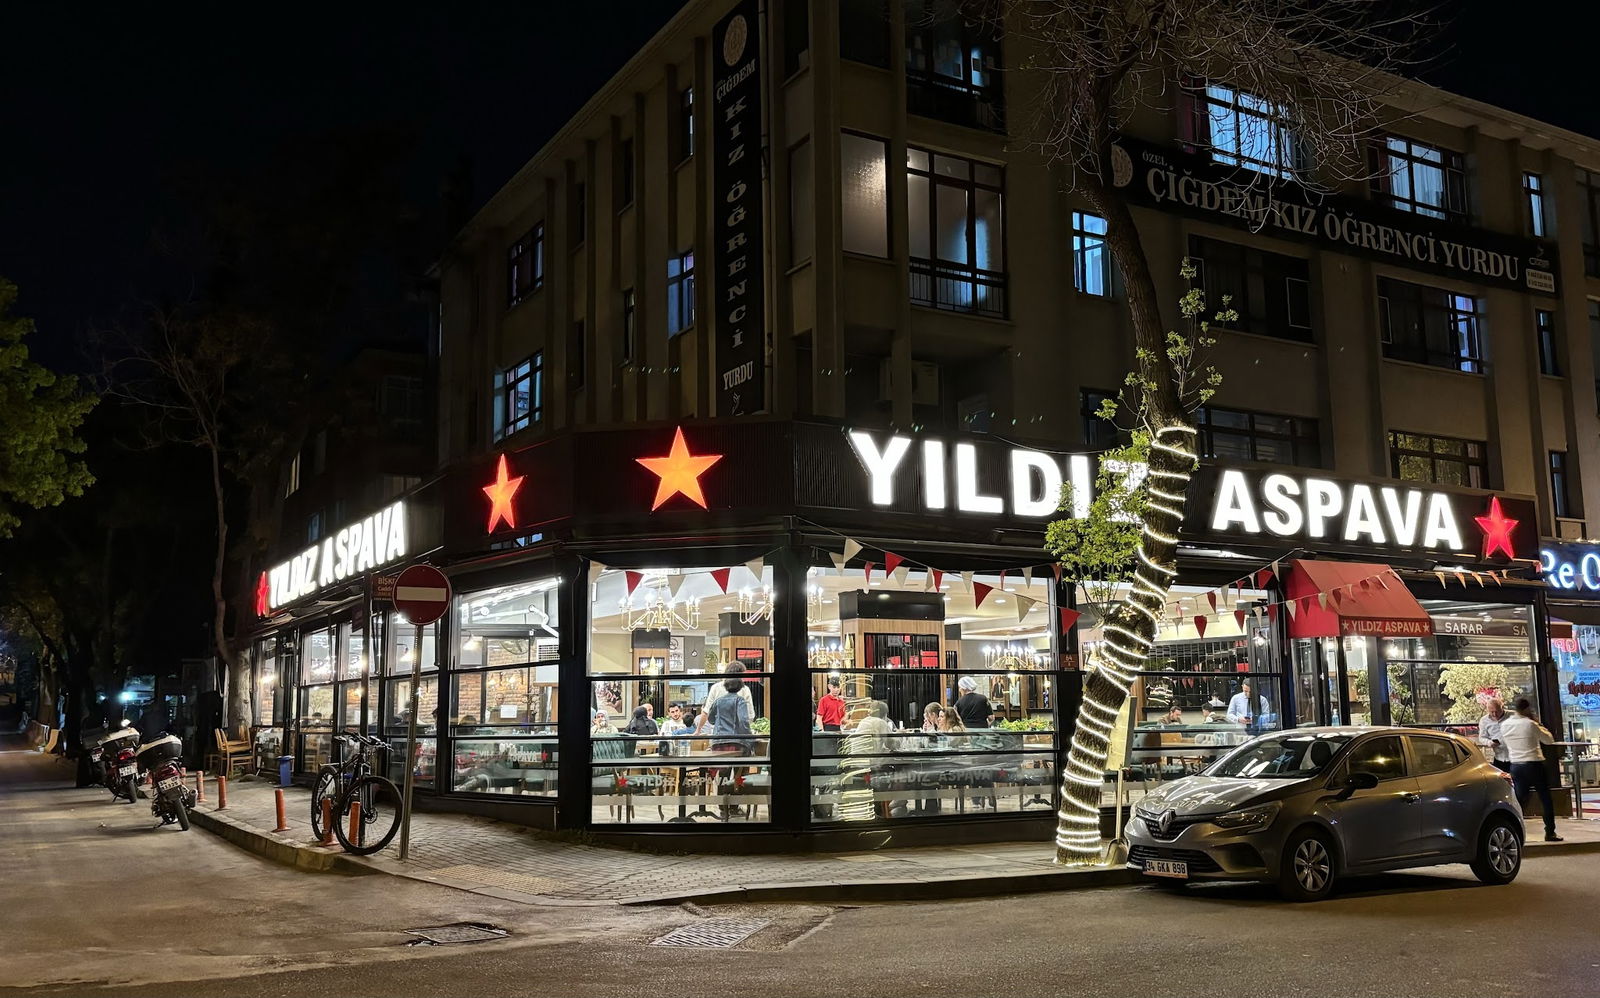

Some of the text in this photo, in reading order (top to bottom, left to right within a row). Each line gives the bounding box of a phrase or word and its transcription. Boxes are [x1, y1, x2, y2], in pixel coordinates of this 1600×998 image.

[1142, 151, 1167, 167] ÖZEL
[725, 96, 748, 348] KIZ ÖĞRENCİ
[1146, 164, 1519, 281] ÇİĞDEM KIZ ÖĞRENCİ YURDU
[723, 361, 753, 391] YURDU
[849, 431, 1463, 550] YILDIZ ASPAVA
[269, 500, 405, 608] YILDIZ ASPAVA
[1352, 620, 1422, 634] YILDIZ ASPAVA
[1444, 622, 1484, 634] SARAR
[1146, 861, 1155, 871] 34
